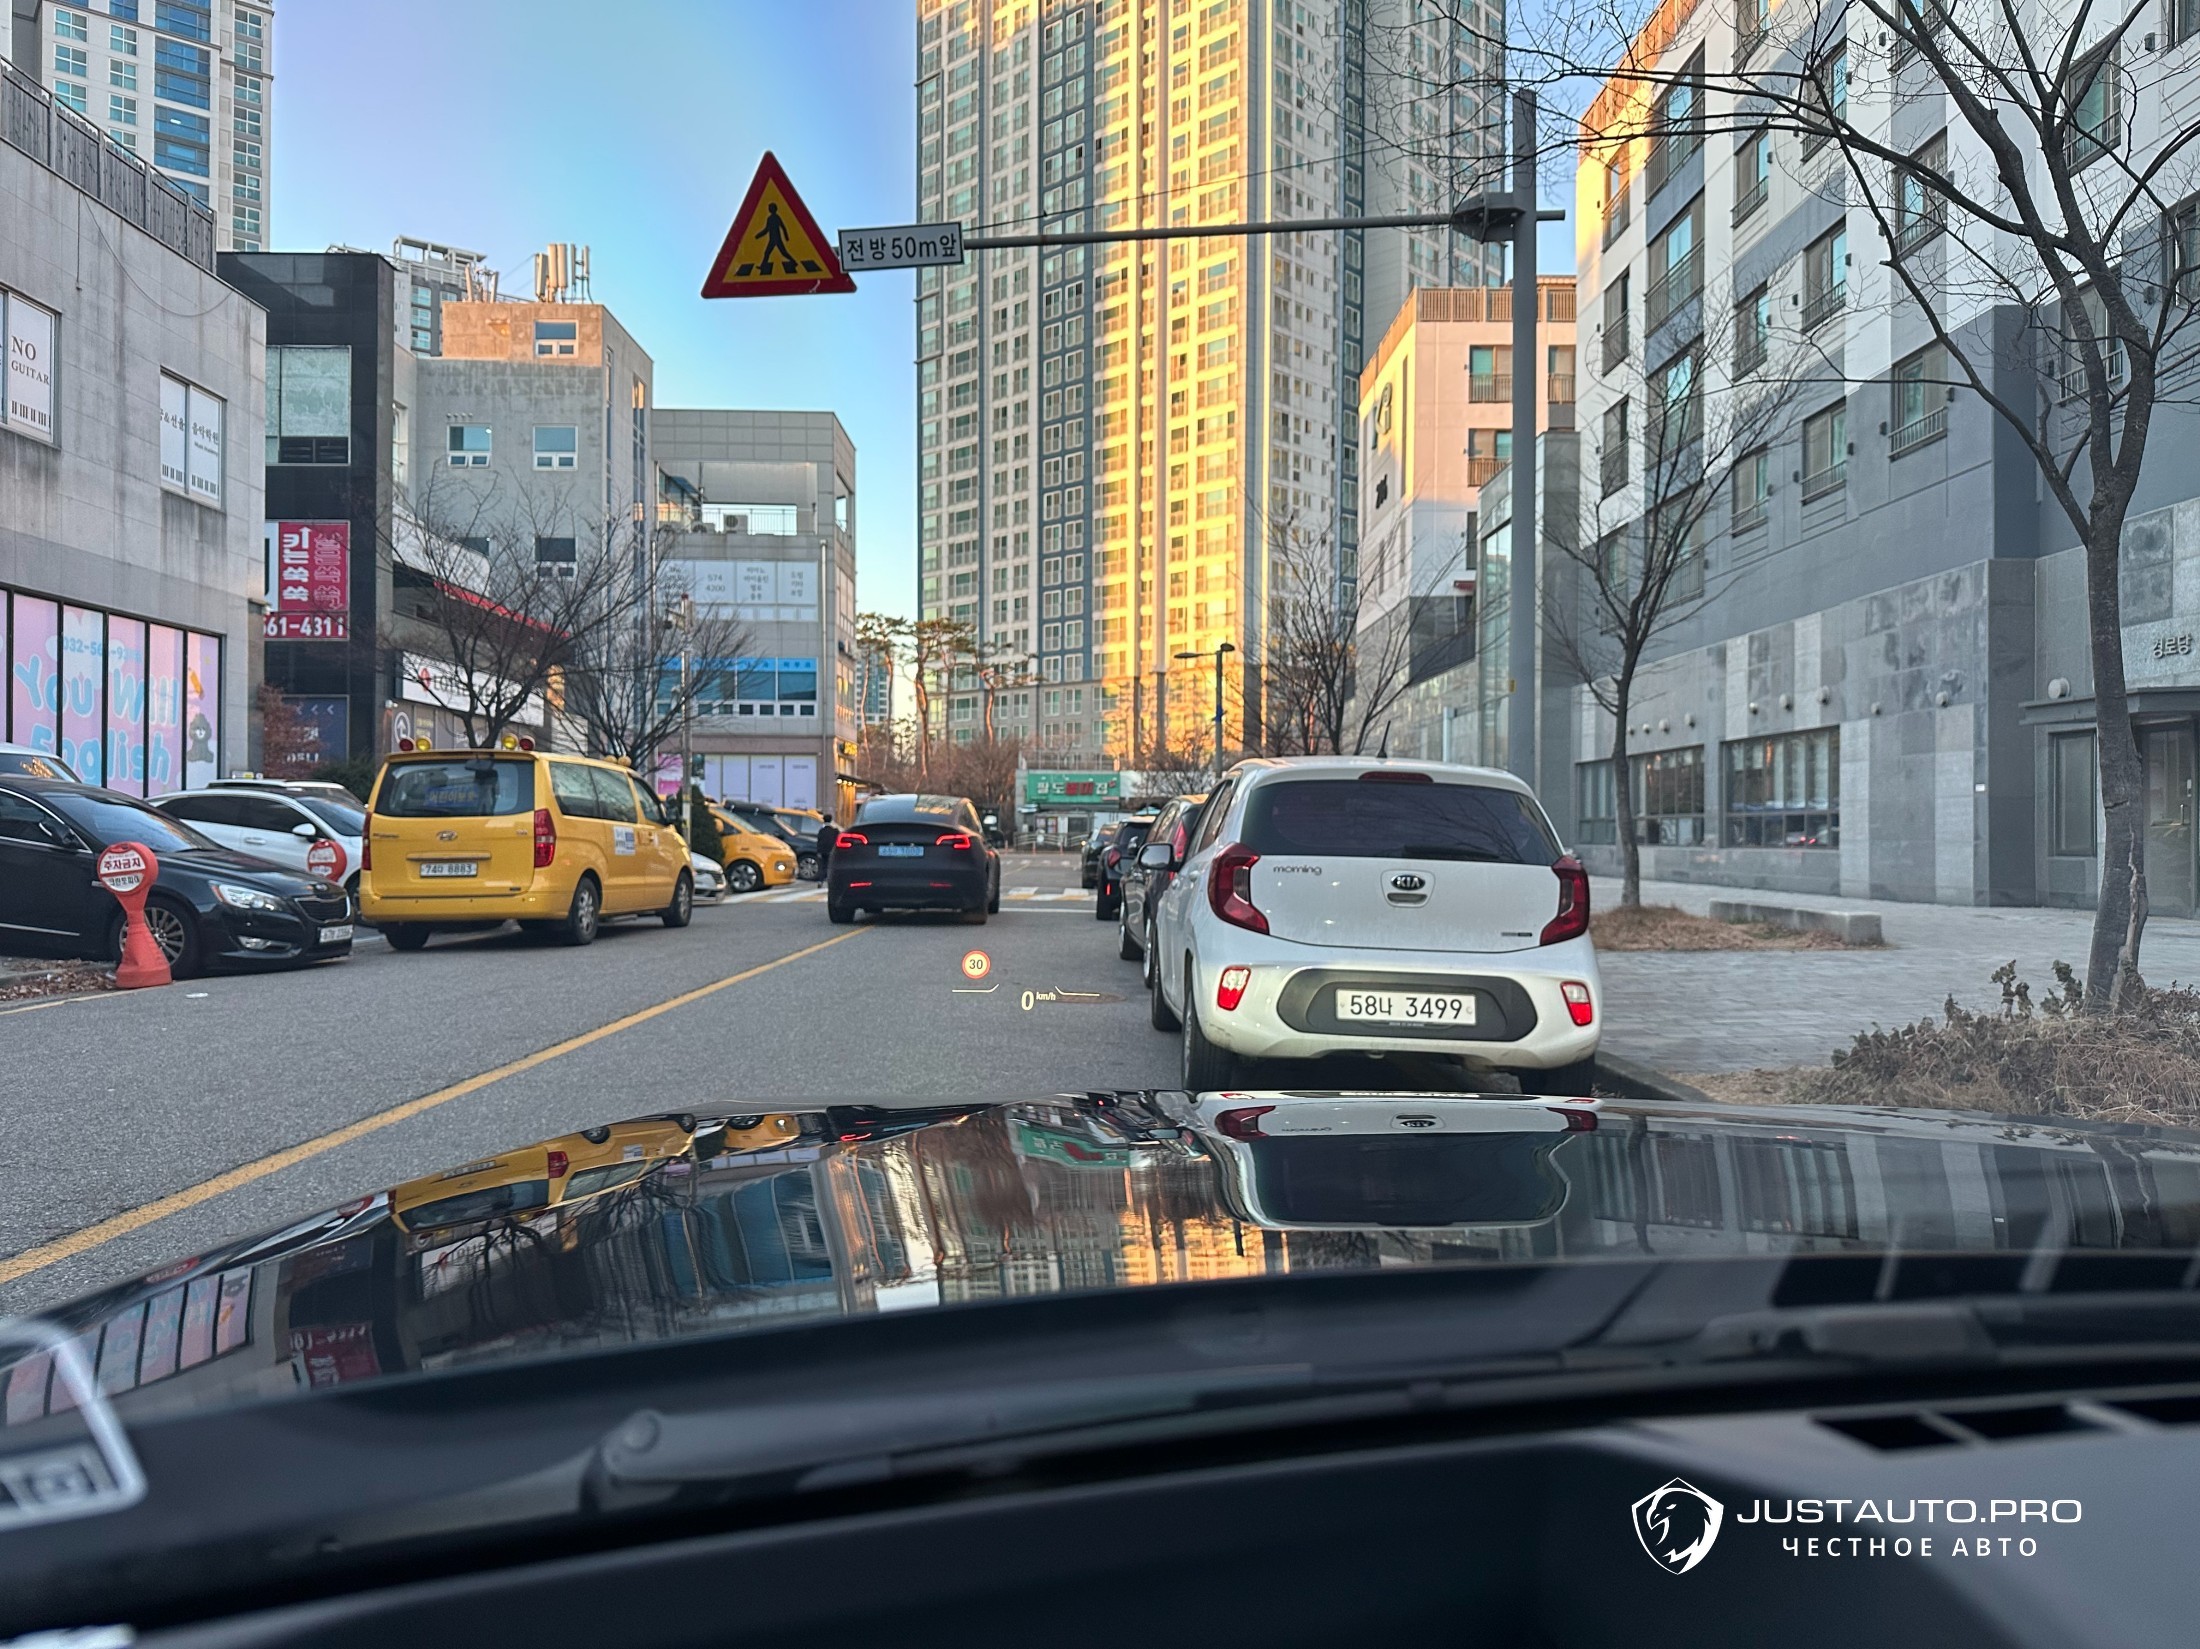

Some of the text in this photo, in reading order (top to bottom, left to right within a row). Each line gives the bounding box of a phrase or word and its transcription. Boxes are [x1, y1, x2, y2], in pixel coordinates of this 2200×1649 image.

[11, 335, 37, 361] NO
[11, 360, 50, 385] GUITAR
[2153, 634, 2191, 659] 경로당
[14, 653, 180, 727] You Will
[30, 723, 171, 787] English
[104, 857, 141, 870] 주차금지
[1273, 864, 1323, 876] morning
[1396, 877, 1420, 888] KIA
[969, 959, 984, 970] 30
[1021, 991, 1056, 1011] 0 km/h
[1350, 995, 1463, 1020] 58나 3499
